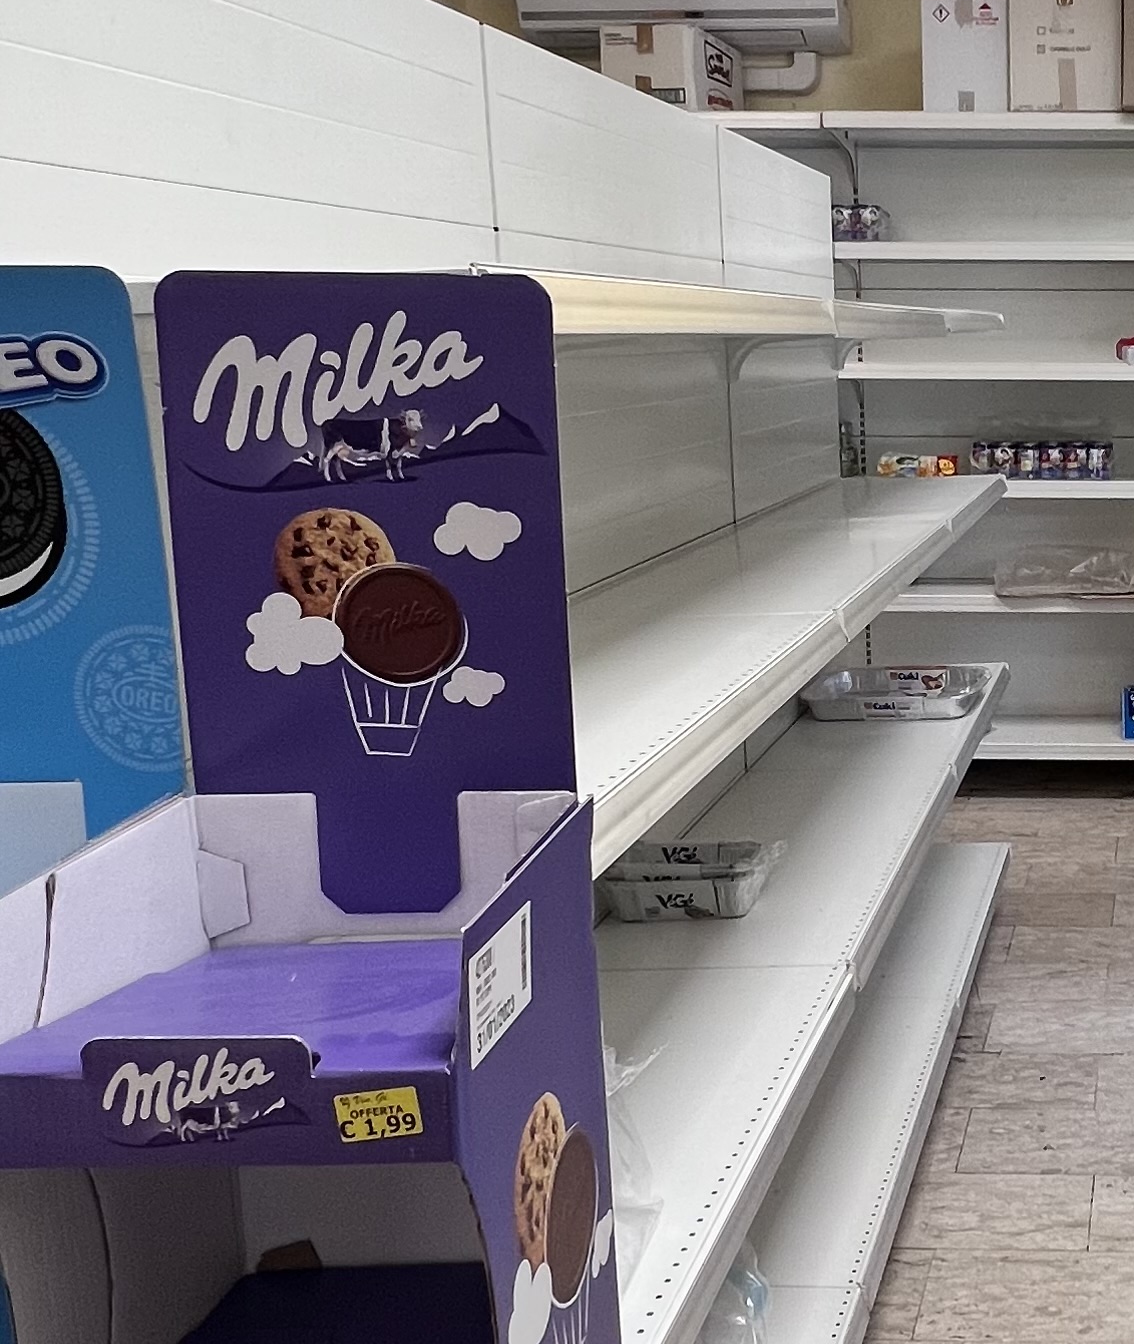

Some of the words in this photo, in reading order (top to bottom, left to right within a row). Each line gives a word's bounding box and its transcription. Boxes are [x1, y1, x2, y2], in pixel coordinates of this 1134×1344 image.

[193, 310, 484, 452] Milka
[102, 1047, 276, 1126] Milka
[349, 1104, 404, 1120] OFFERTA
[364, 1112, 417, 1139] 1,99
